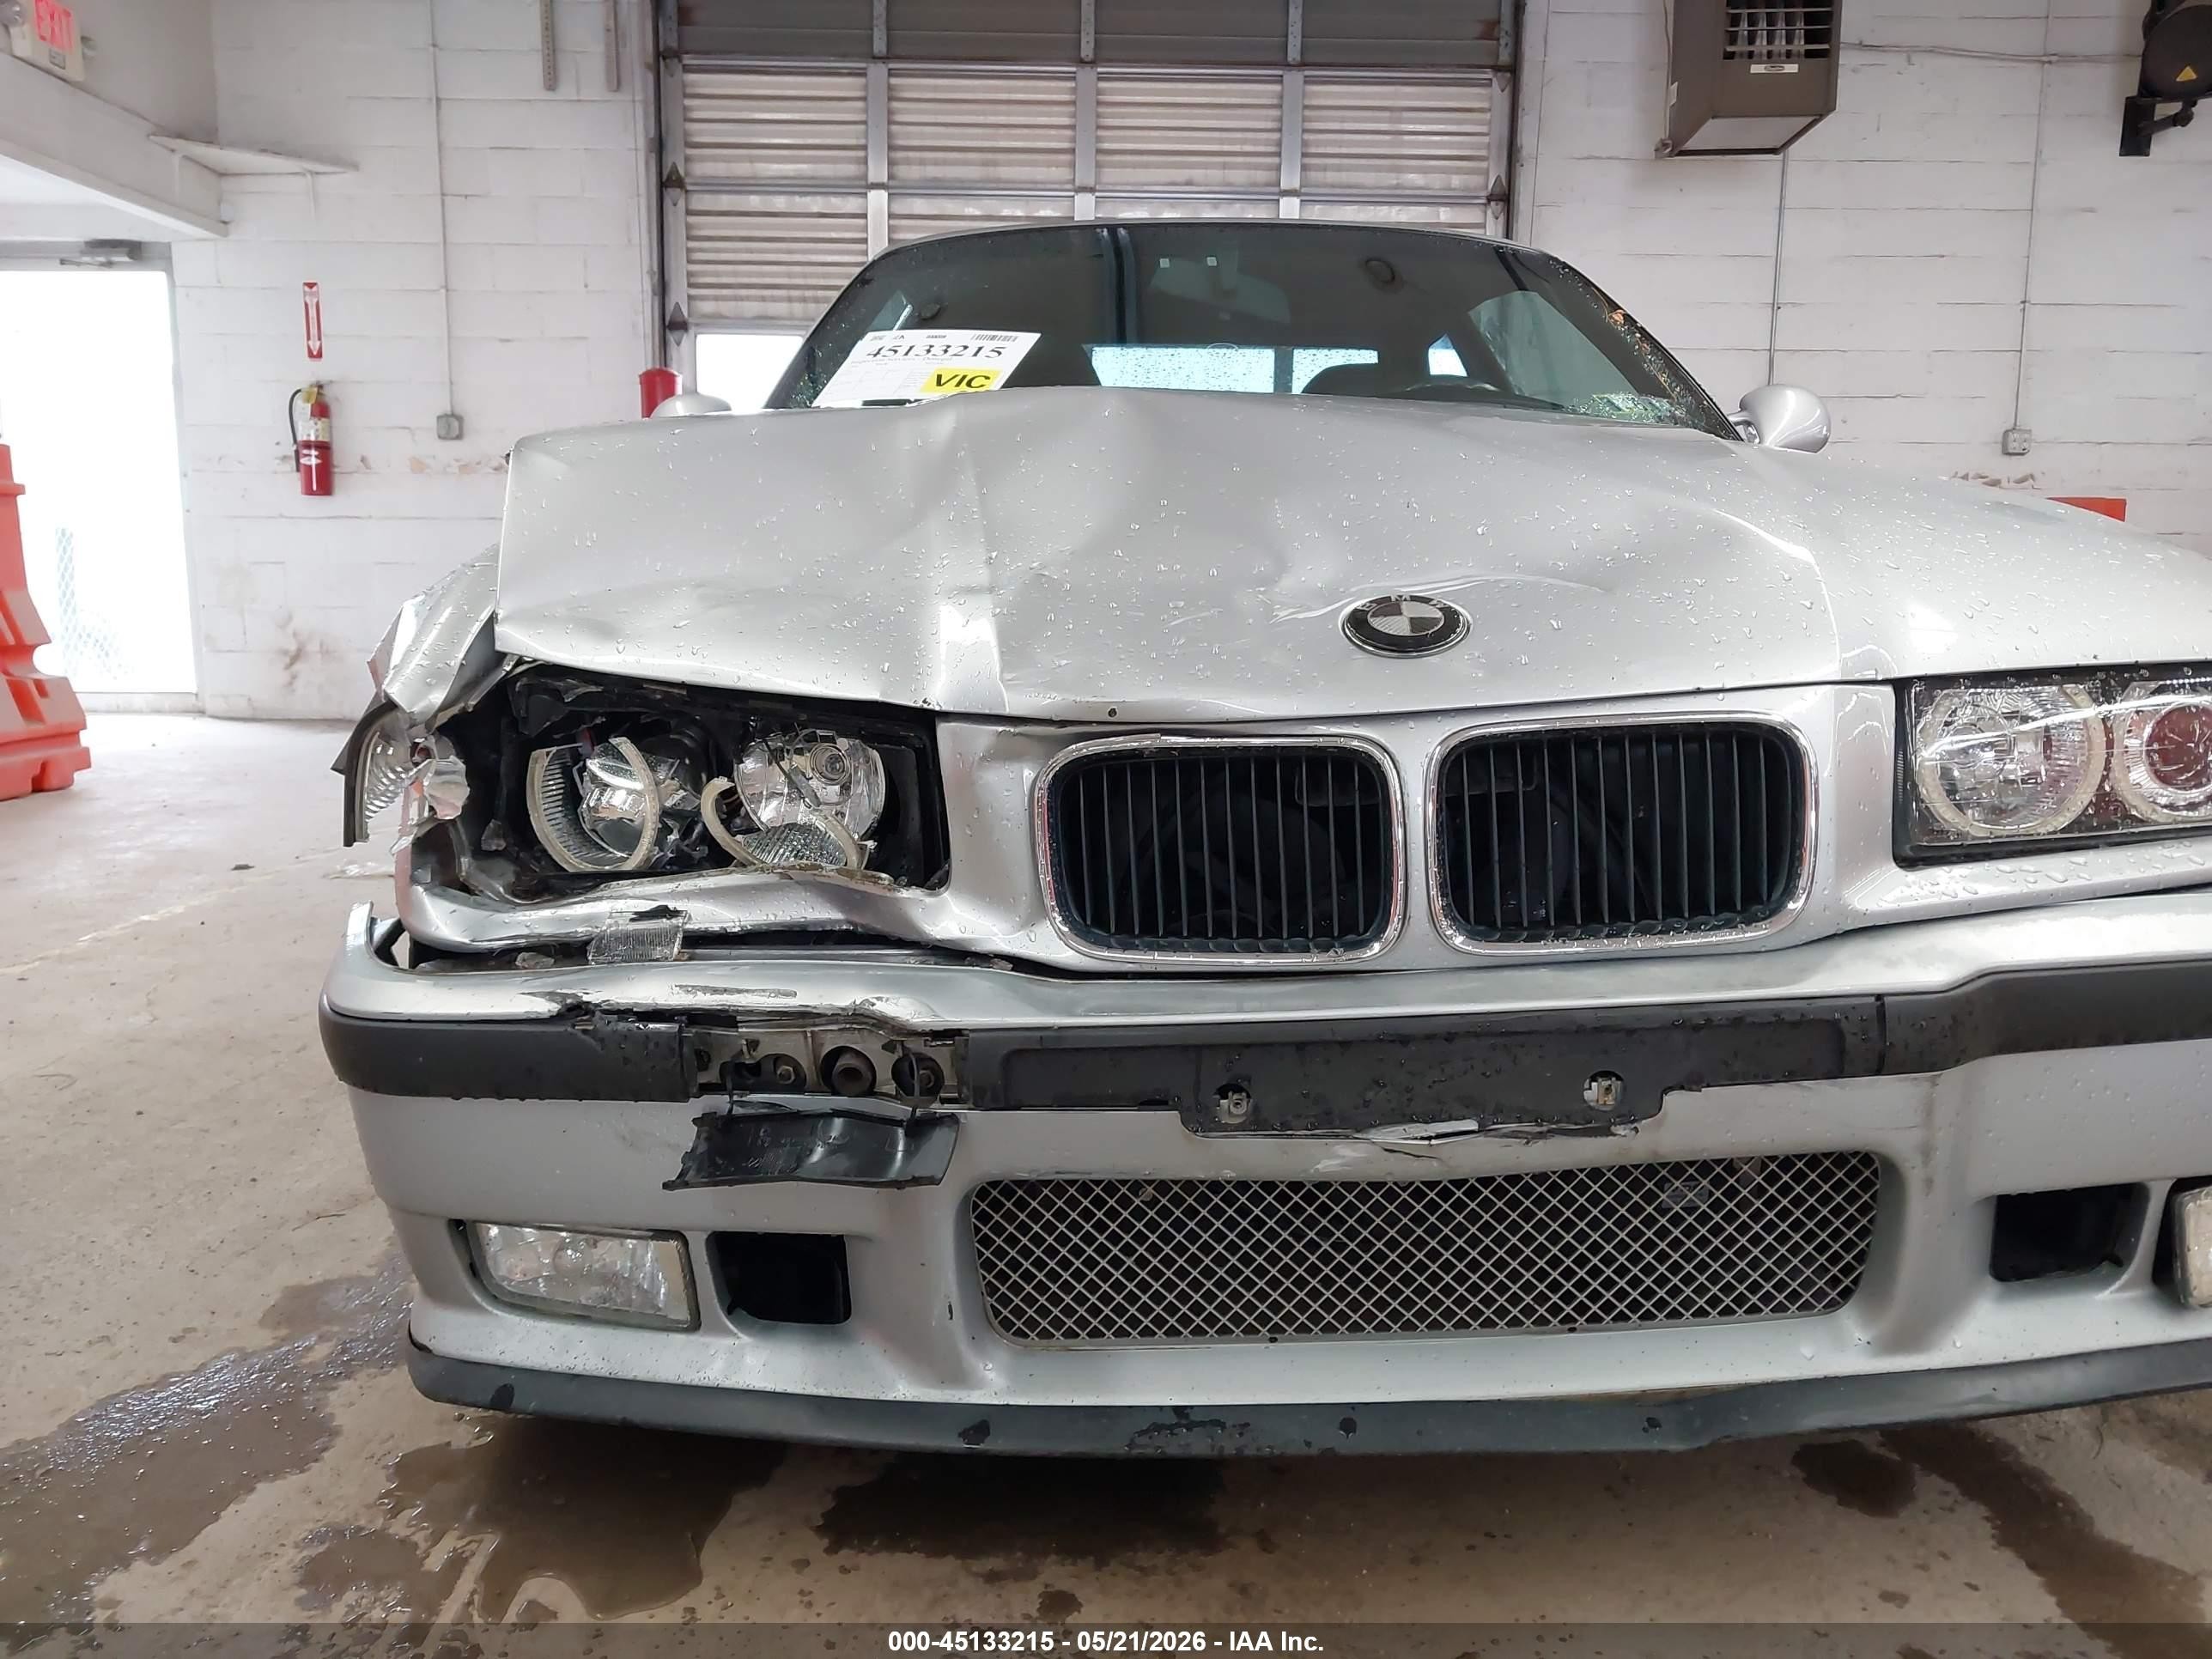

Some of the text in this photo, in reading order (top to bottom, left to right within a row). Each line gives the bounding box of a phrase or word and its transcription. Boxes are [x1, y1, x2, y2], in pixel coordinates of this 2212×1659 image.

[866, 344, 1008, 359] 45133215
[935, 374, 991, 389] VIC
[1356, 593, 1450, 611] BMW
